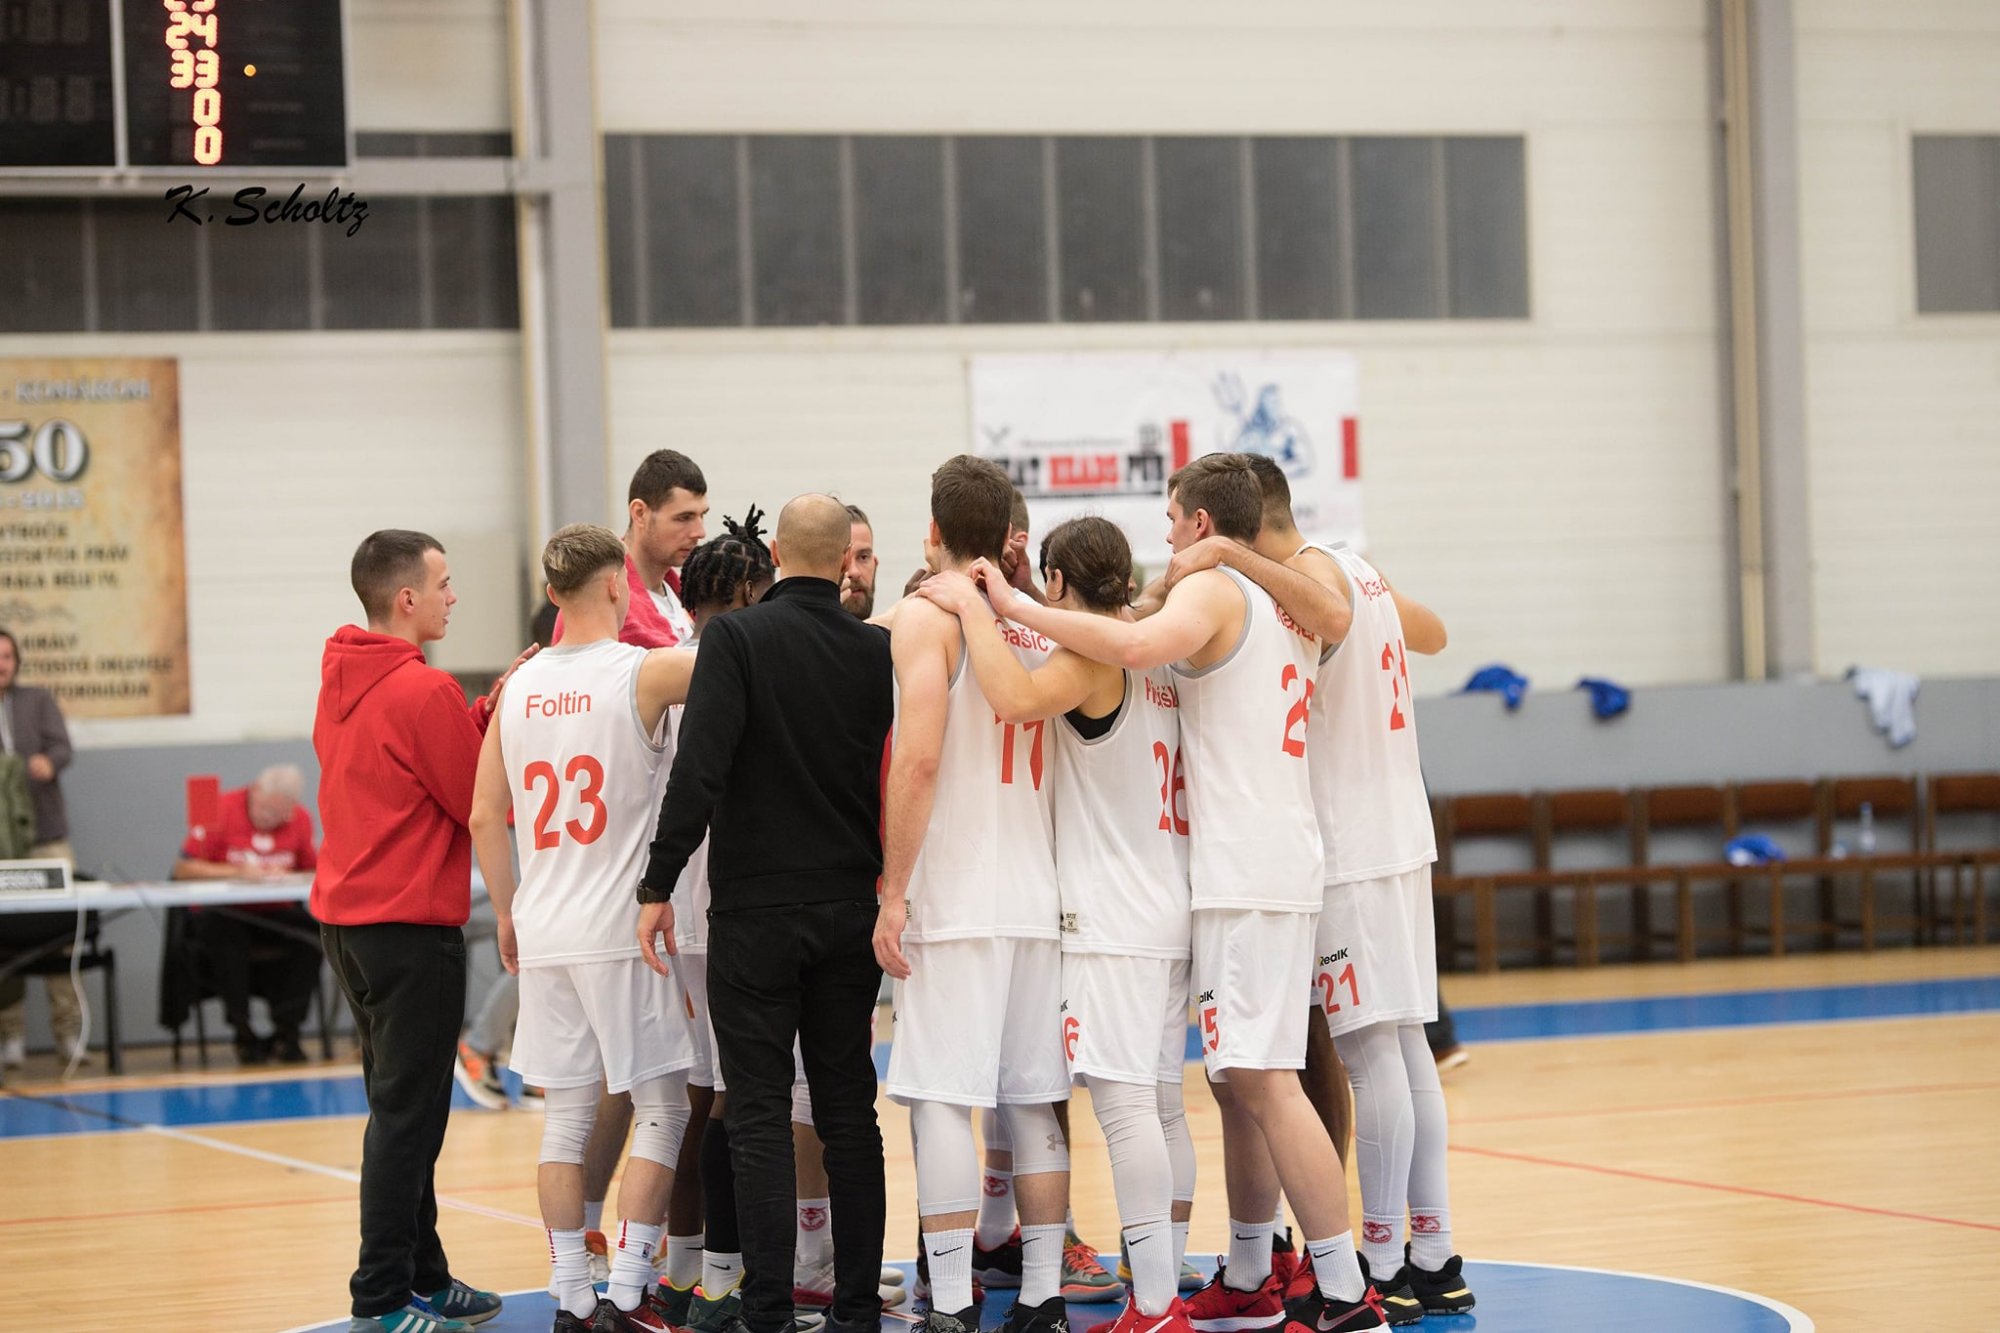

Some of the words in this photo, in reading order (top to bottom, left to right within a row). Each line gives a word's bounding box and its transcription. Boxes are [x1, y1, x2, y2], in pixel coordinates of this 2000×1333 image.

[165, 11, 218, 50] 24
[170, 49, 220, 89] 33
[526, 691, 591, 718] Foltin
[1281, 663, 1314, 758] 2
[524, 755, 607, 851] 23
[1153, 741, 1190, 836] 26
[1318, 963, 1360, 1015] 21
[1199, 1007, 1219, 1055] 5
